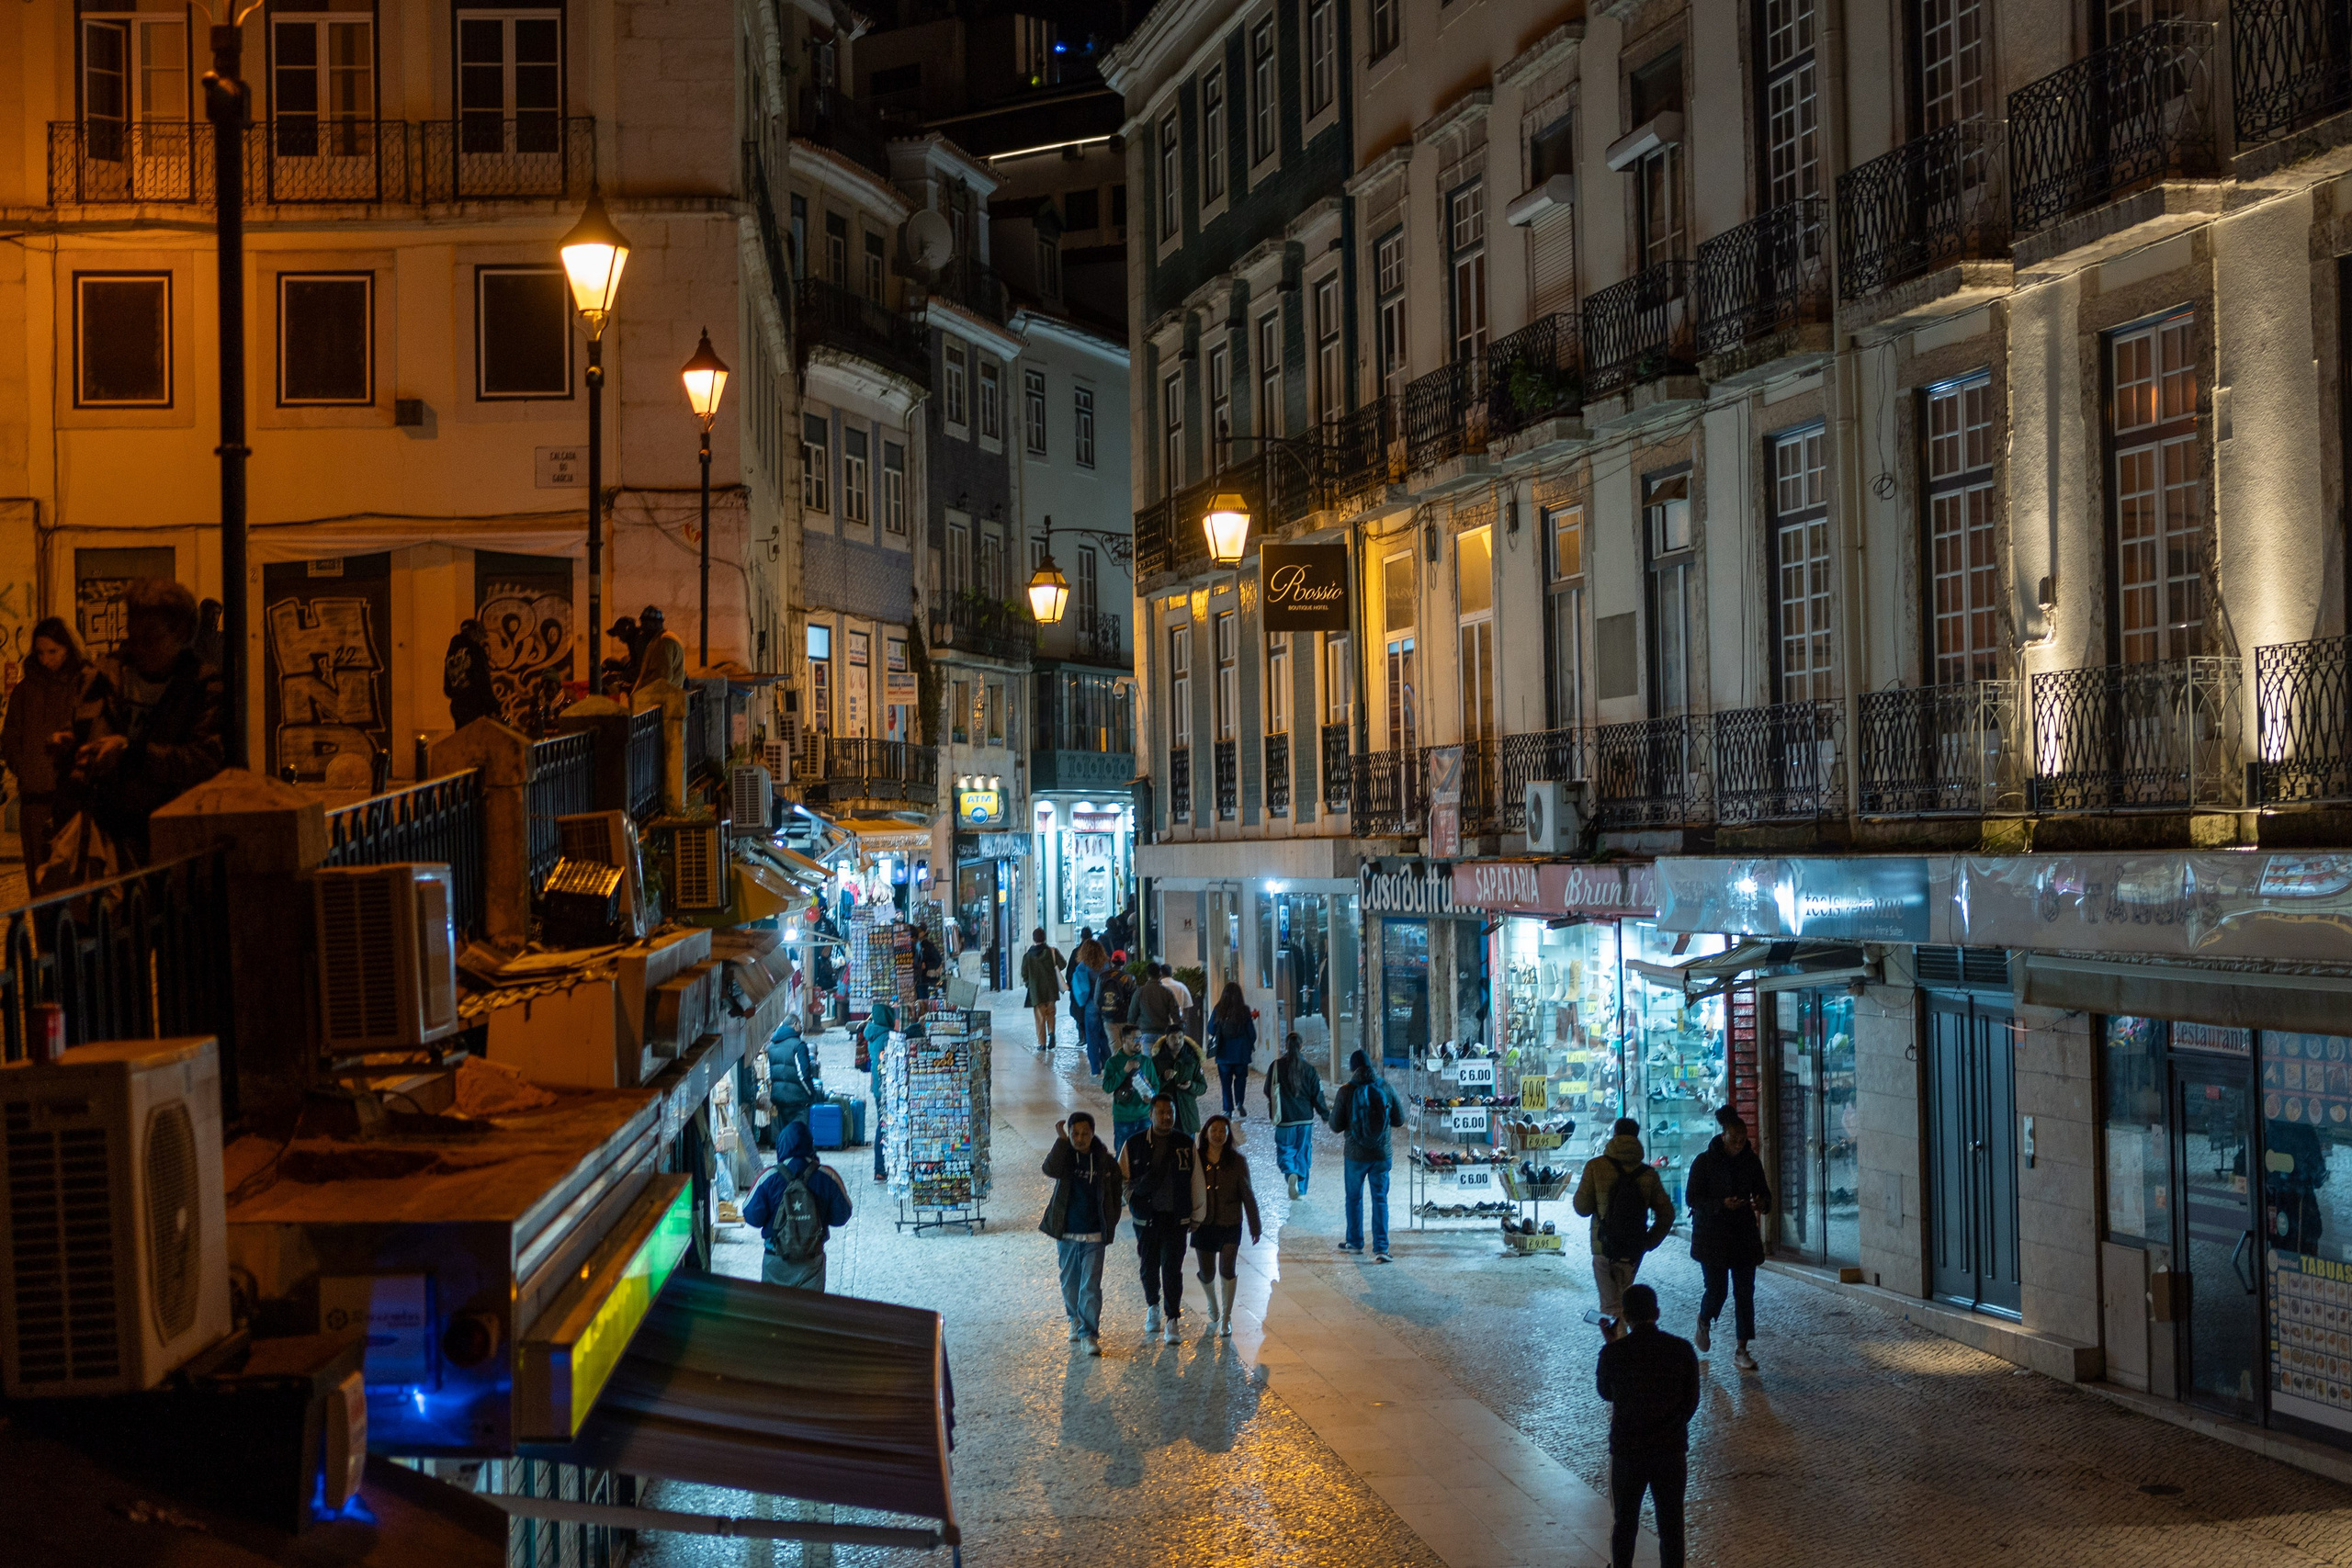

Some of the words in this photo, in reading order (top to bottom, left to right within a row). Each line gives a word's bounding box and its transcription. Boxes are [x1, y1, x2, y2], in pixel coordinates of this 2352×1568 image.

[1268, 564, 1344, 603] Rossio
[967, 795, 992, 804] ATM
[1475, 866, 1540, 904] SAPATARIA
[1460, 1069, 1466, 1081] €
[1468, 1069, 1491, 1081] 6.00
[1453, 1117, 1460, 1129] €
[1463, 1117, 1485, 1128] 6.00
[1460, 1174, 1466, 1185] €
[1468, 1173, 1488, 1185] 6.00
[786, 1213, 811, 1222] COVERSE
[2300, 1255, 2352, 1282] TABUAS
